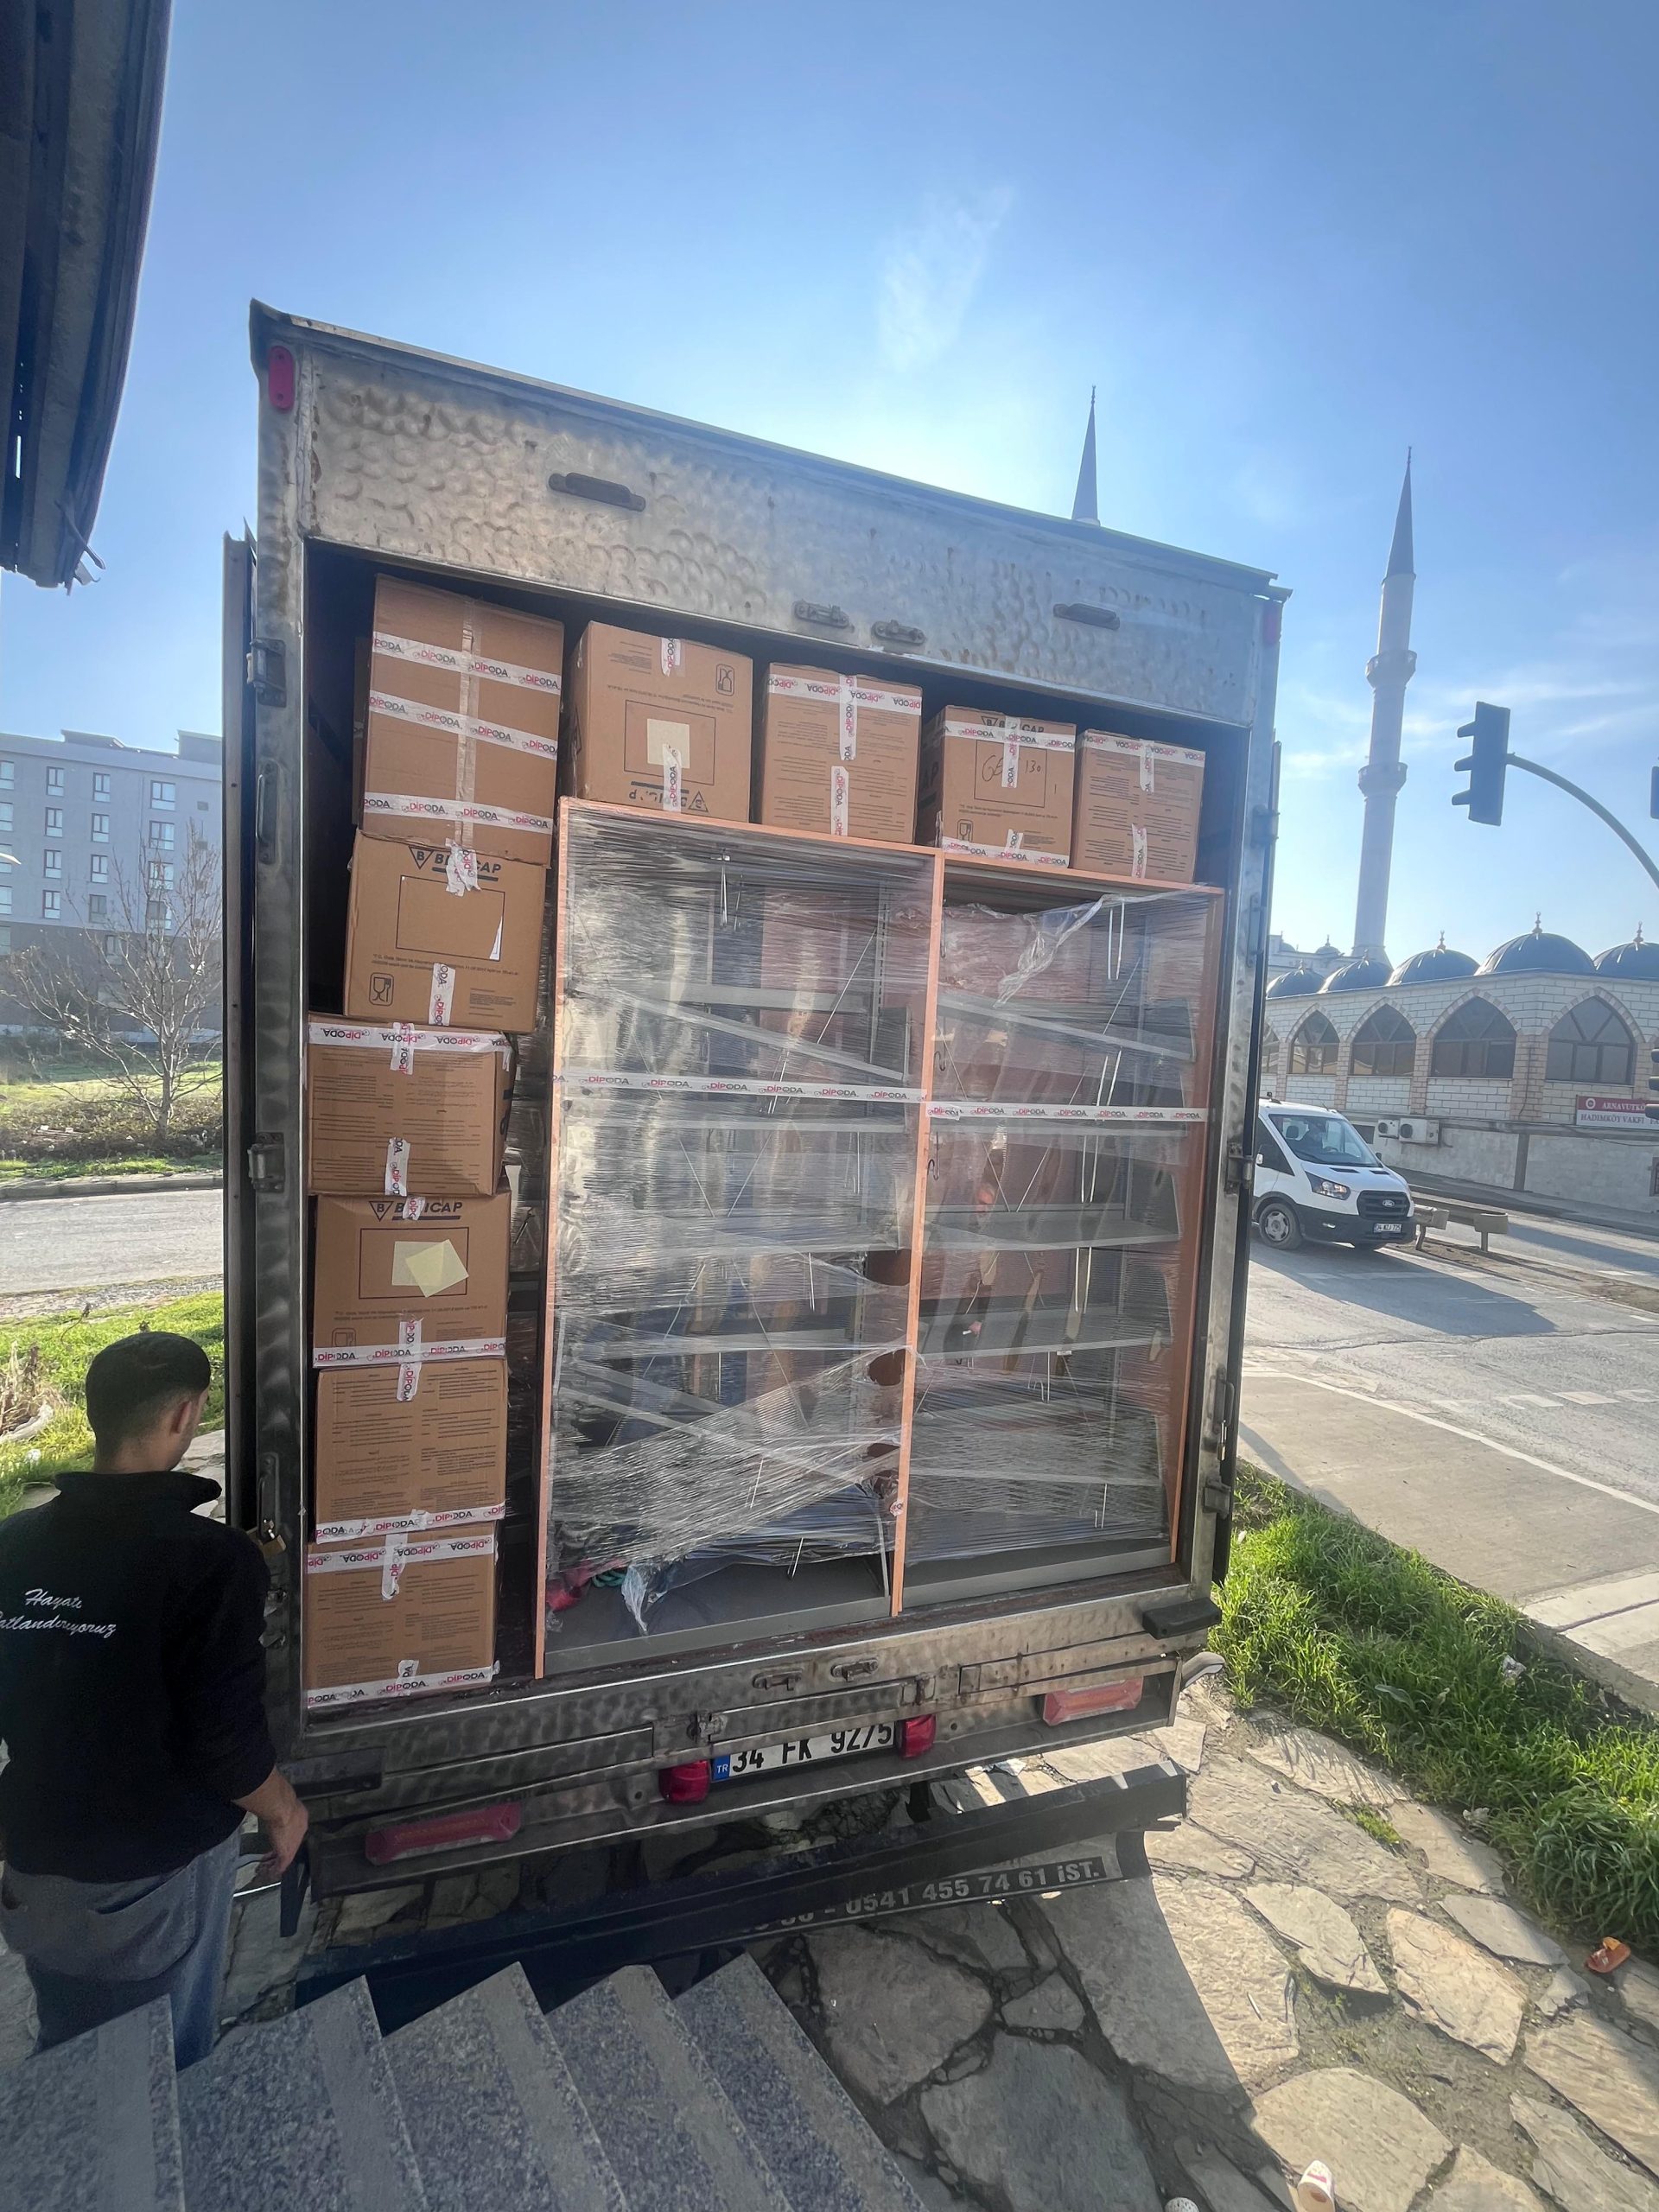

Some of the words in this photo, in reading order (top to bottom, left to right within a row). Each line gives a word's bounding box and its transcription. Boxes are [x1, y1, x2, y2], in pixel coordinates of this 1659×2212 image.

[474, 662, 508, 677] DİPODA
[525, 674, 559, 690] DİPODA
[410, 802, 445, 815] DİPODA
[323, 1028, 361, 1039] DİPODA
[448, 1672, 485, 1683] DİPODA
[716, 1764, 729, 1774] TR
[732, 1749, 764, 1772] 34
[922, 1878, 969, 1901] 455
[978, 1873, 1011, 1894] 74
[1018, 1868, 1047, 1888] 61
